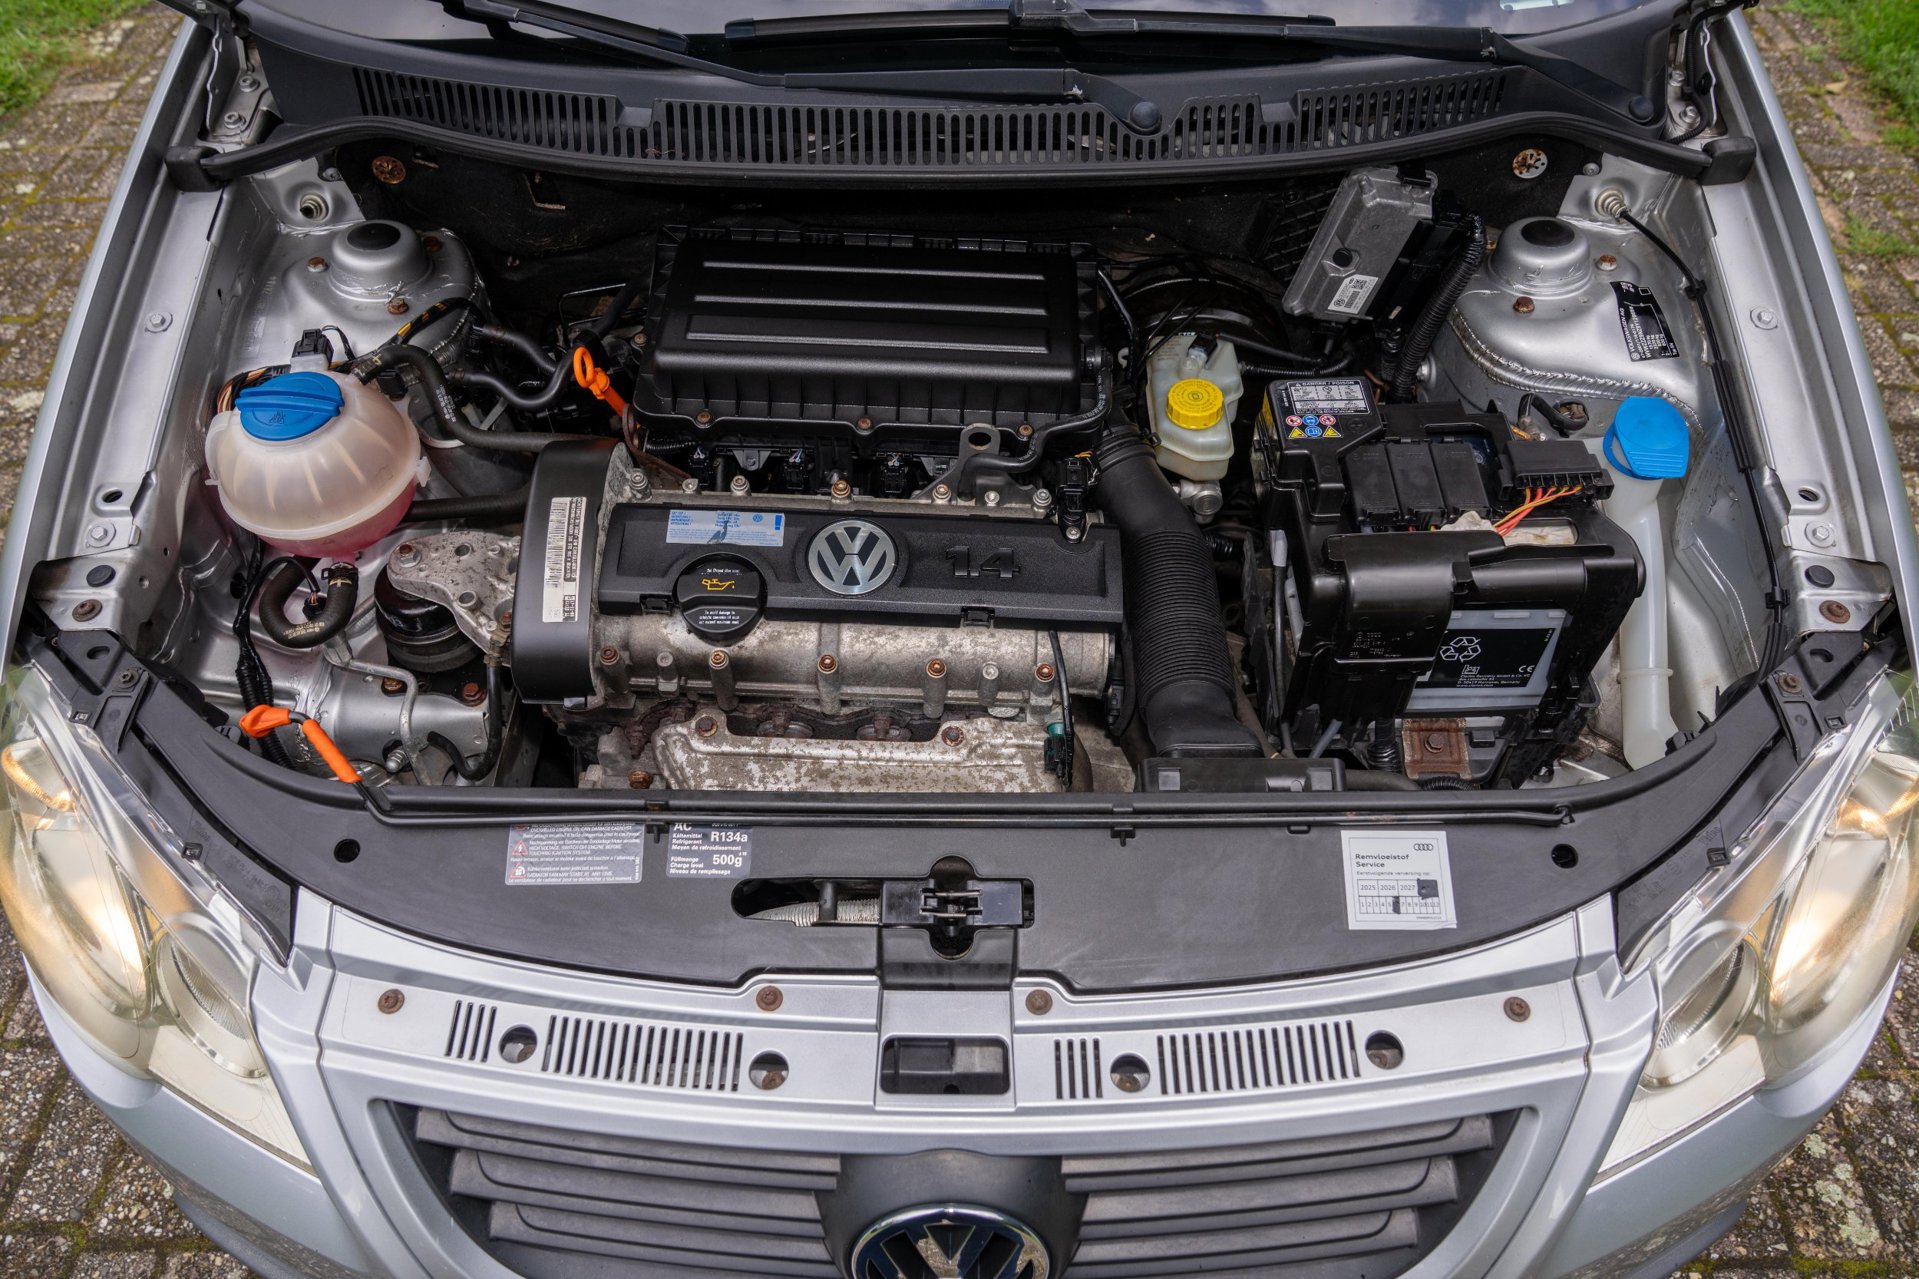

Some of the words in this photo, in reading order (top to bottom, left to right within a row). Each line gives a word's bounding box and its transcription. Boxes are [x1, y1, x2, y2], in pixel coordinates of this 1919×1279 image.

[1620, 308, 1625, 316] AG
[1621, 316, 1635, 352] VOLKSWAGEN
[808, 520, 896, 594] VW
[946, 546, 1020, 578] 1.4
[674, 822, 692, 831] AC
[711, 831, 748, 842] R134a
[712, 854, 742, 867] 500g
